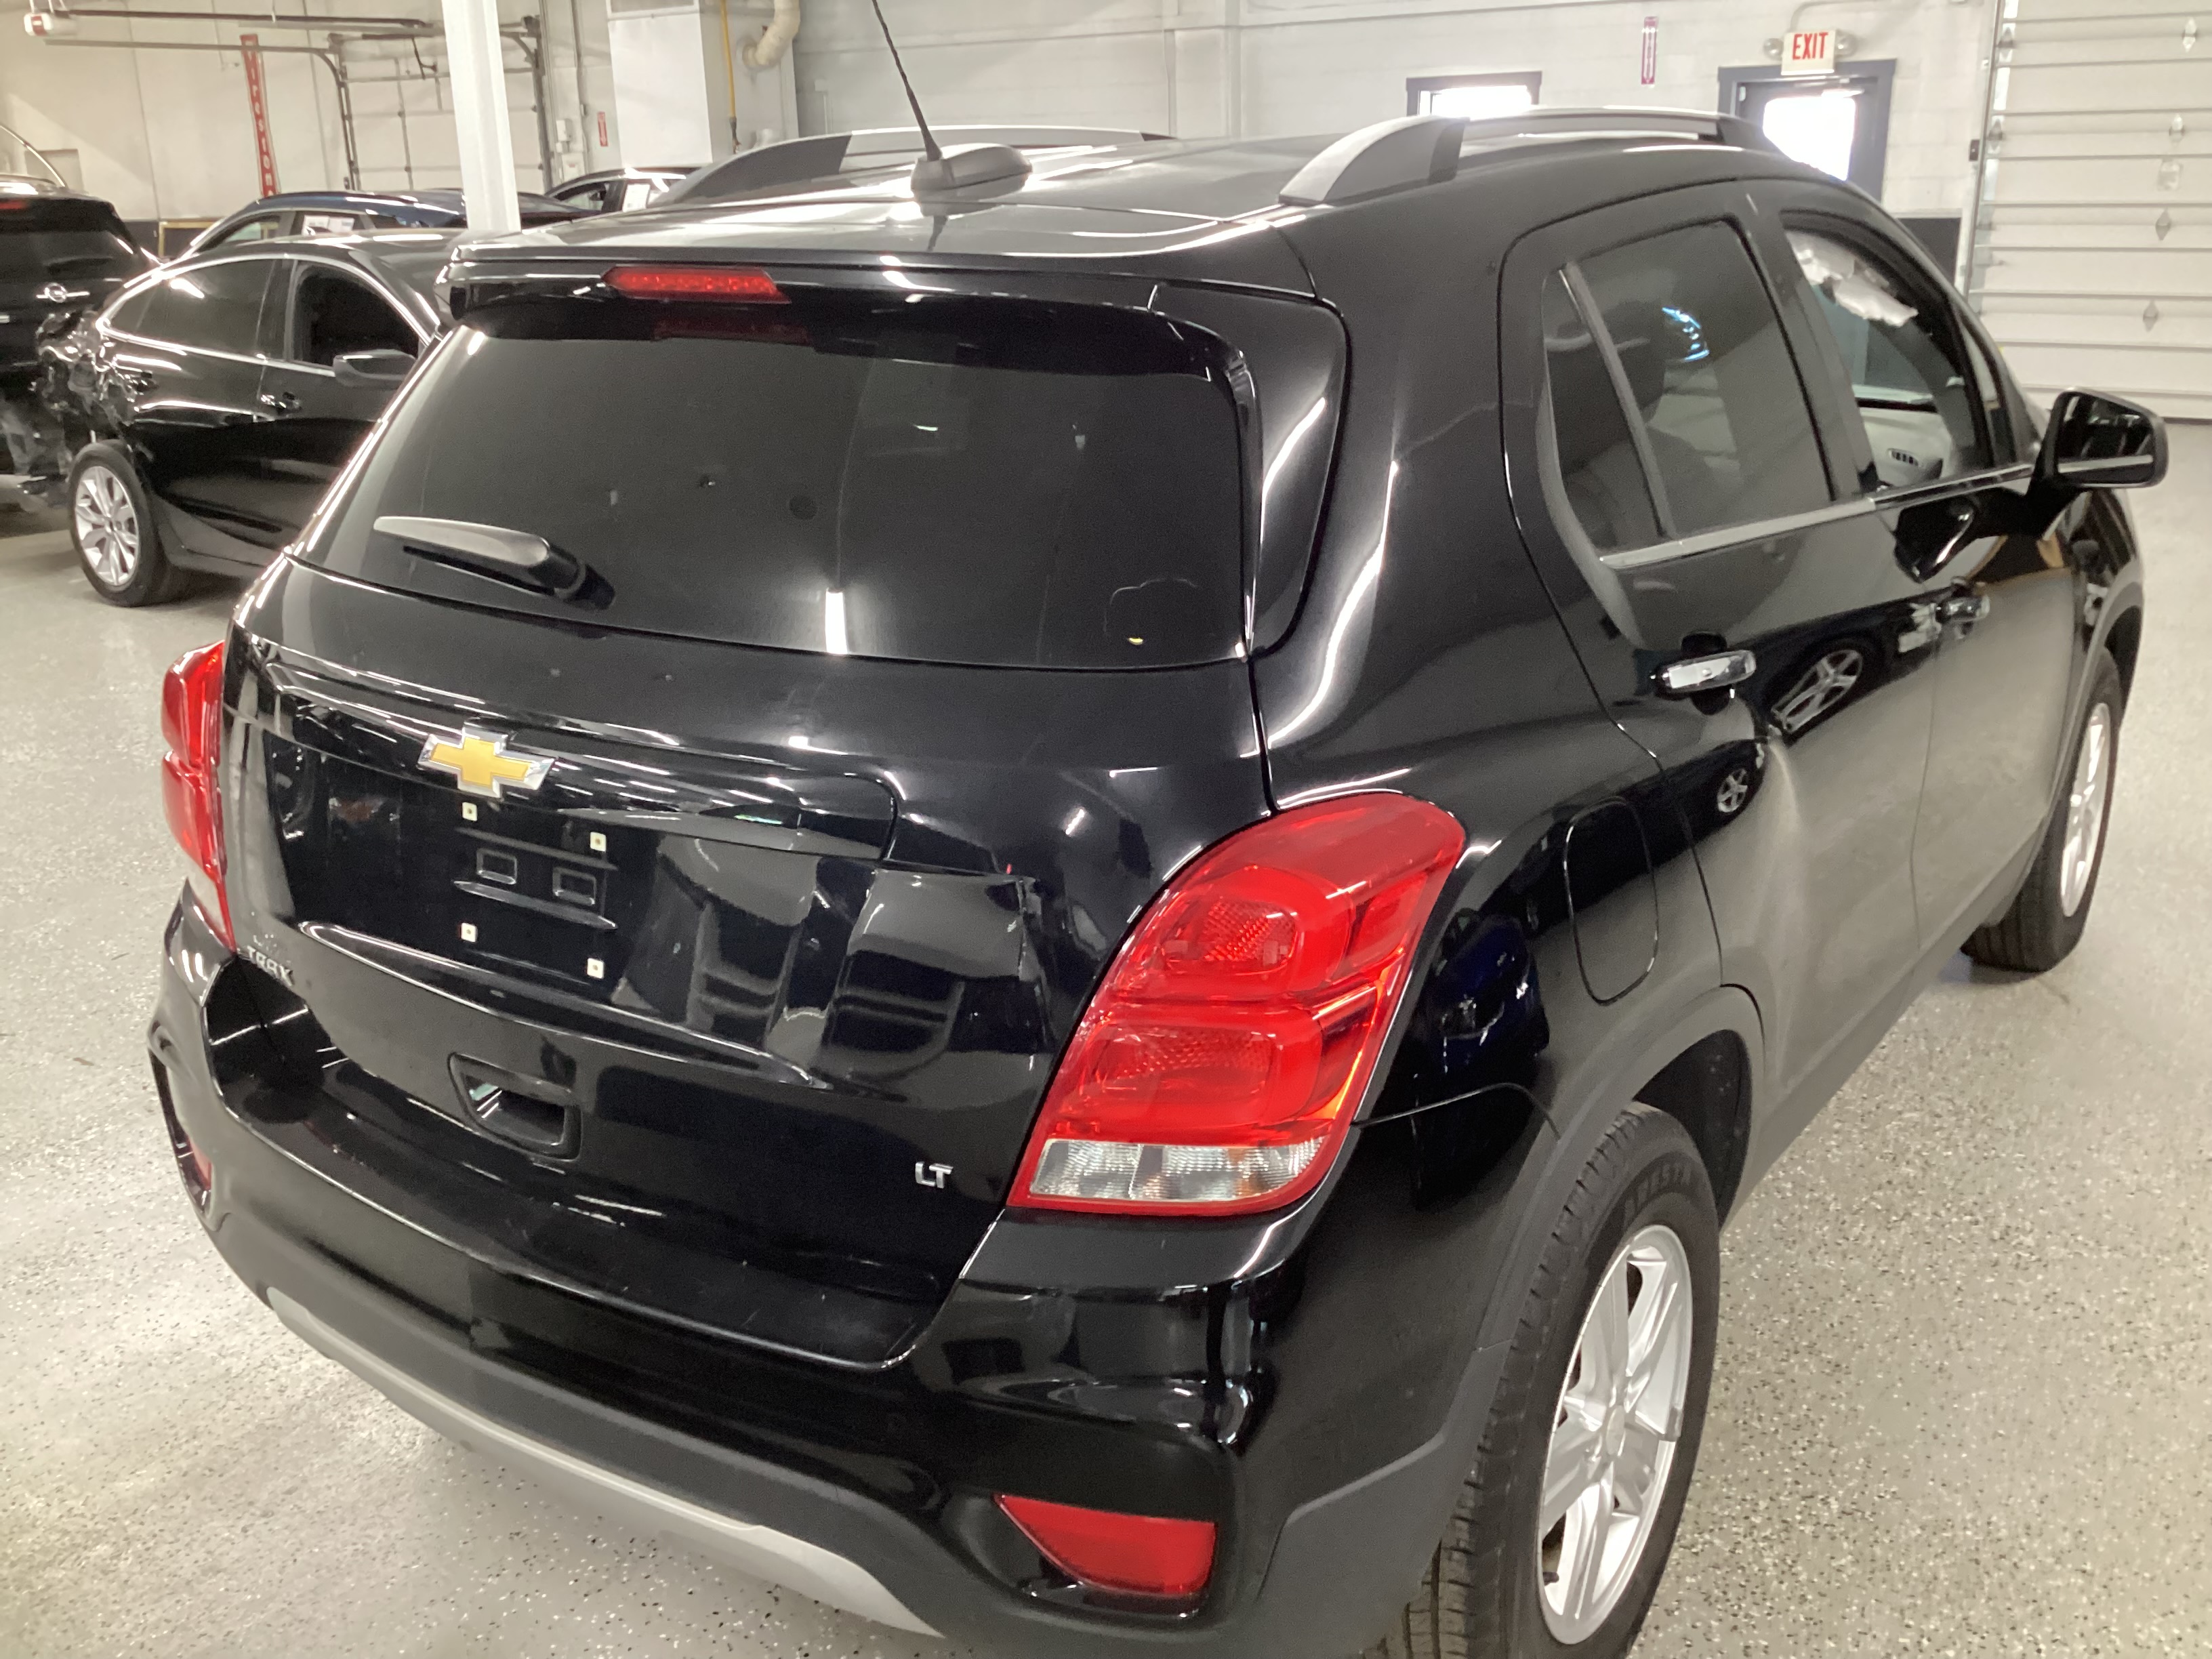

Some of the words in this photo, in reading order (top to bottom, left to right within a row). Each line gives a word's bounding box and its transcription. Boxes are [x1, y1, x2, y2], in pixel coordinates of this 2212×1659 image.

[1792, 32, 1828, 60] EXIT
[245, 41, 274, 195] Fireston
[247, 945, 293, 987] TRAX
[915, 1161, 954, 1189] LT
